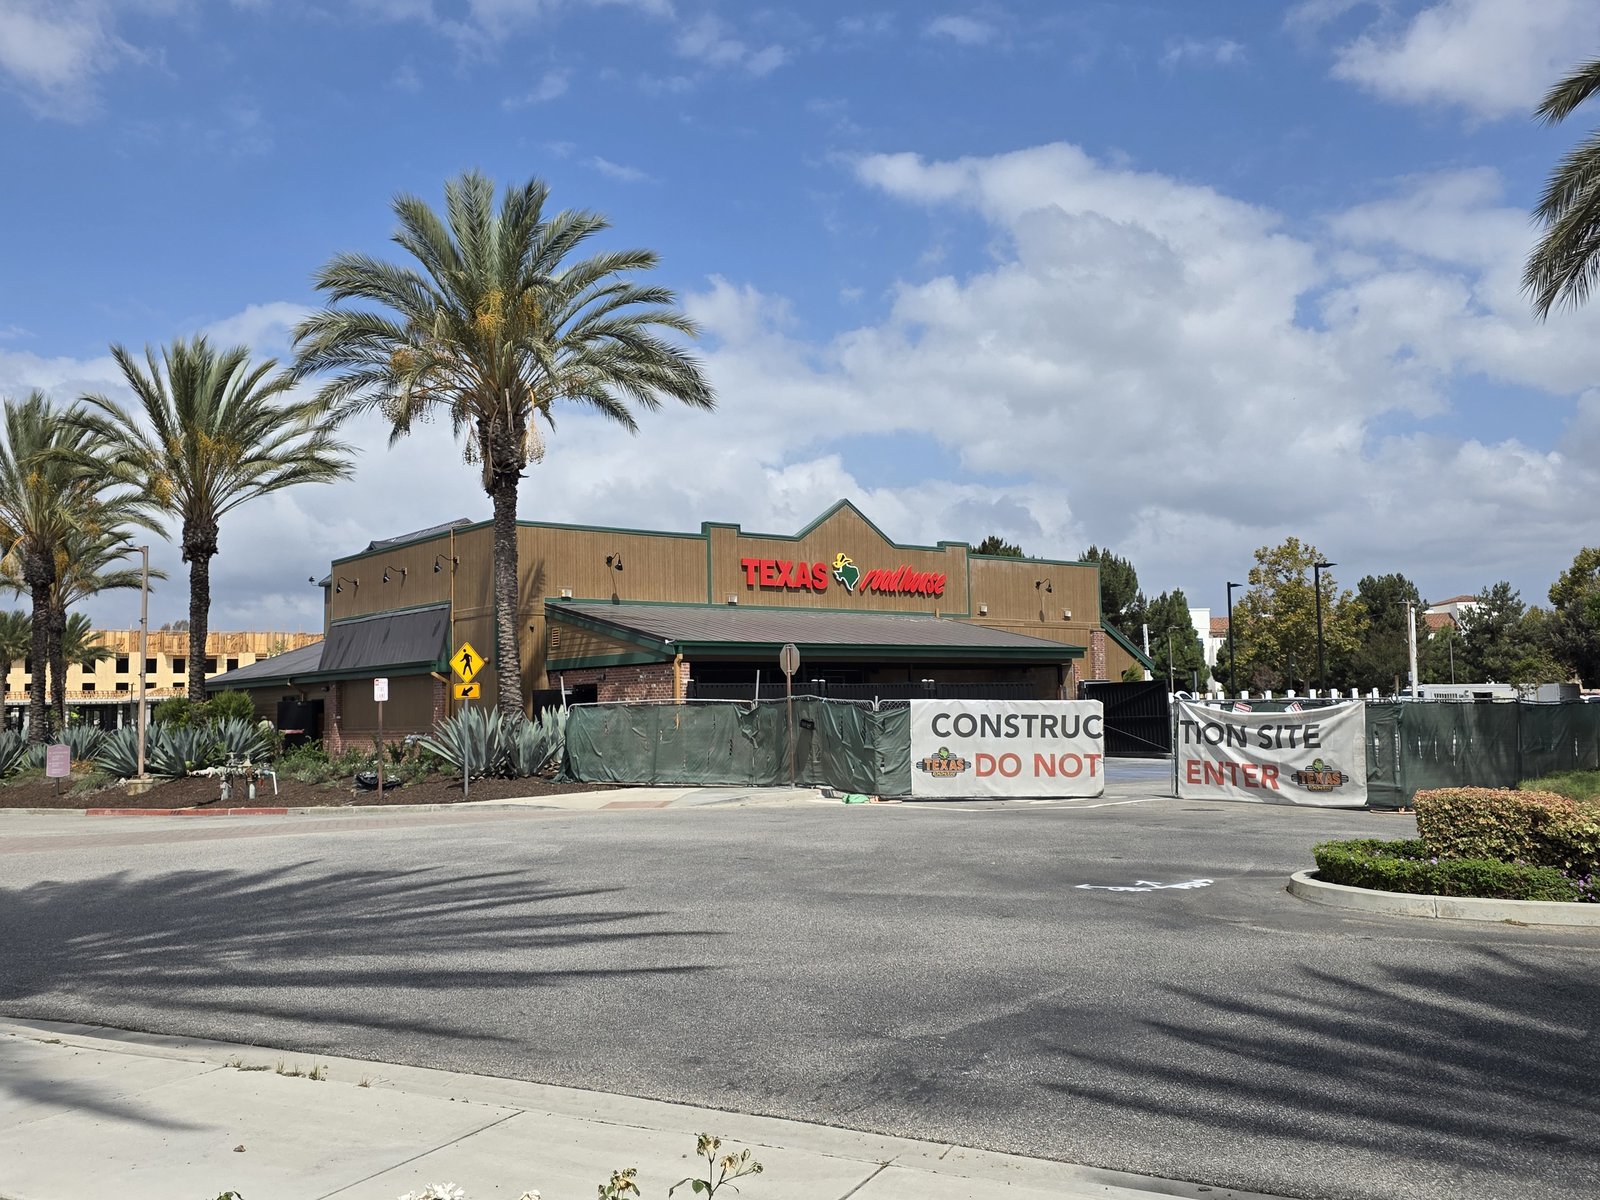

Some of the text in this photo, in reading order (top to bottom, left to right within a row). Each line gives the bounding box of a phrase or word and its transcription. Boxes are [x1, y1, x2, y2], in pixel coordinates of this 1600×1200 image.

[741, 558, 828, 589] TEXAS
[931, 713, 1103, 739] CONSTRUC
[1180, 720, 1321, 749] TION SITE
[924, 758, 965, 771] TEXAS
[975, 753, 1102, 778] DO NOT
[1187, 759, 1279, 790] ENTER
[1299, 772, 1341, 785] TEXAS
